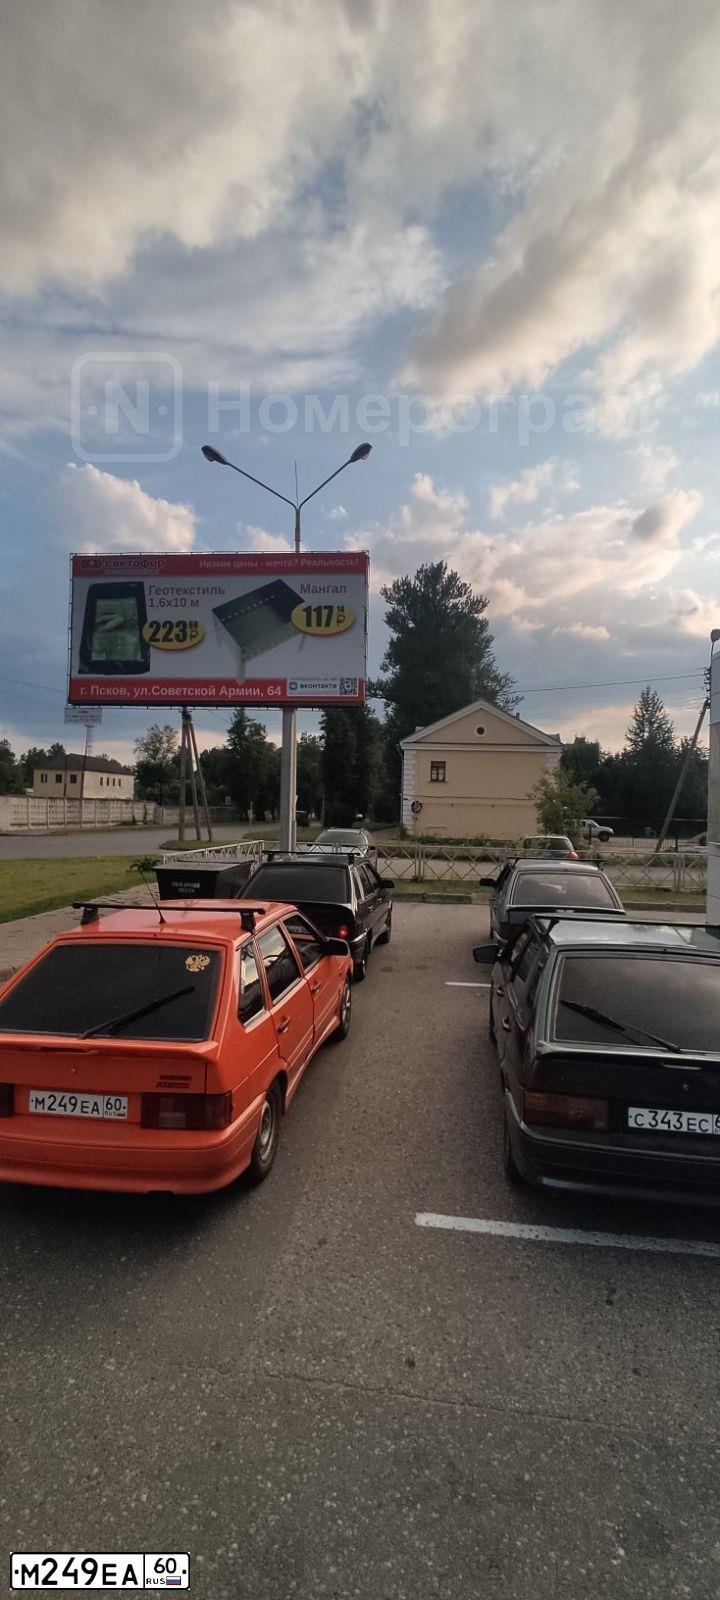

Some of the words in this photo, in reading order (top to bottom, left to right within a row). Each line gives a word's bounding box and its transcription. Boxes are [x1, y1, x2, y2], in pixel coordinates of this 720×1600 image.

[233, 561, 258, 569] цены
[148, 585, 226, 596] Геотекстиль
[300, 583, 347, 594] Мангал
[302, 605, 334, 627] 117
[149, 620, 187, 643] 223
[80, 686, 87, 695] г.
[91, 685, 130, 696] Псков,
[219, 685, 264, 698] Армии,
[267, 685, 282, 696] 64
[34, 1094, 100, 1114] М249ЕА
[105, 1097, 122, 1111] 60
